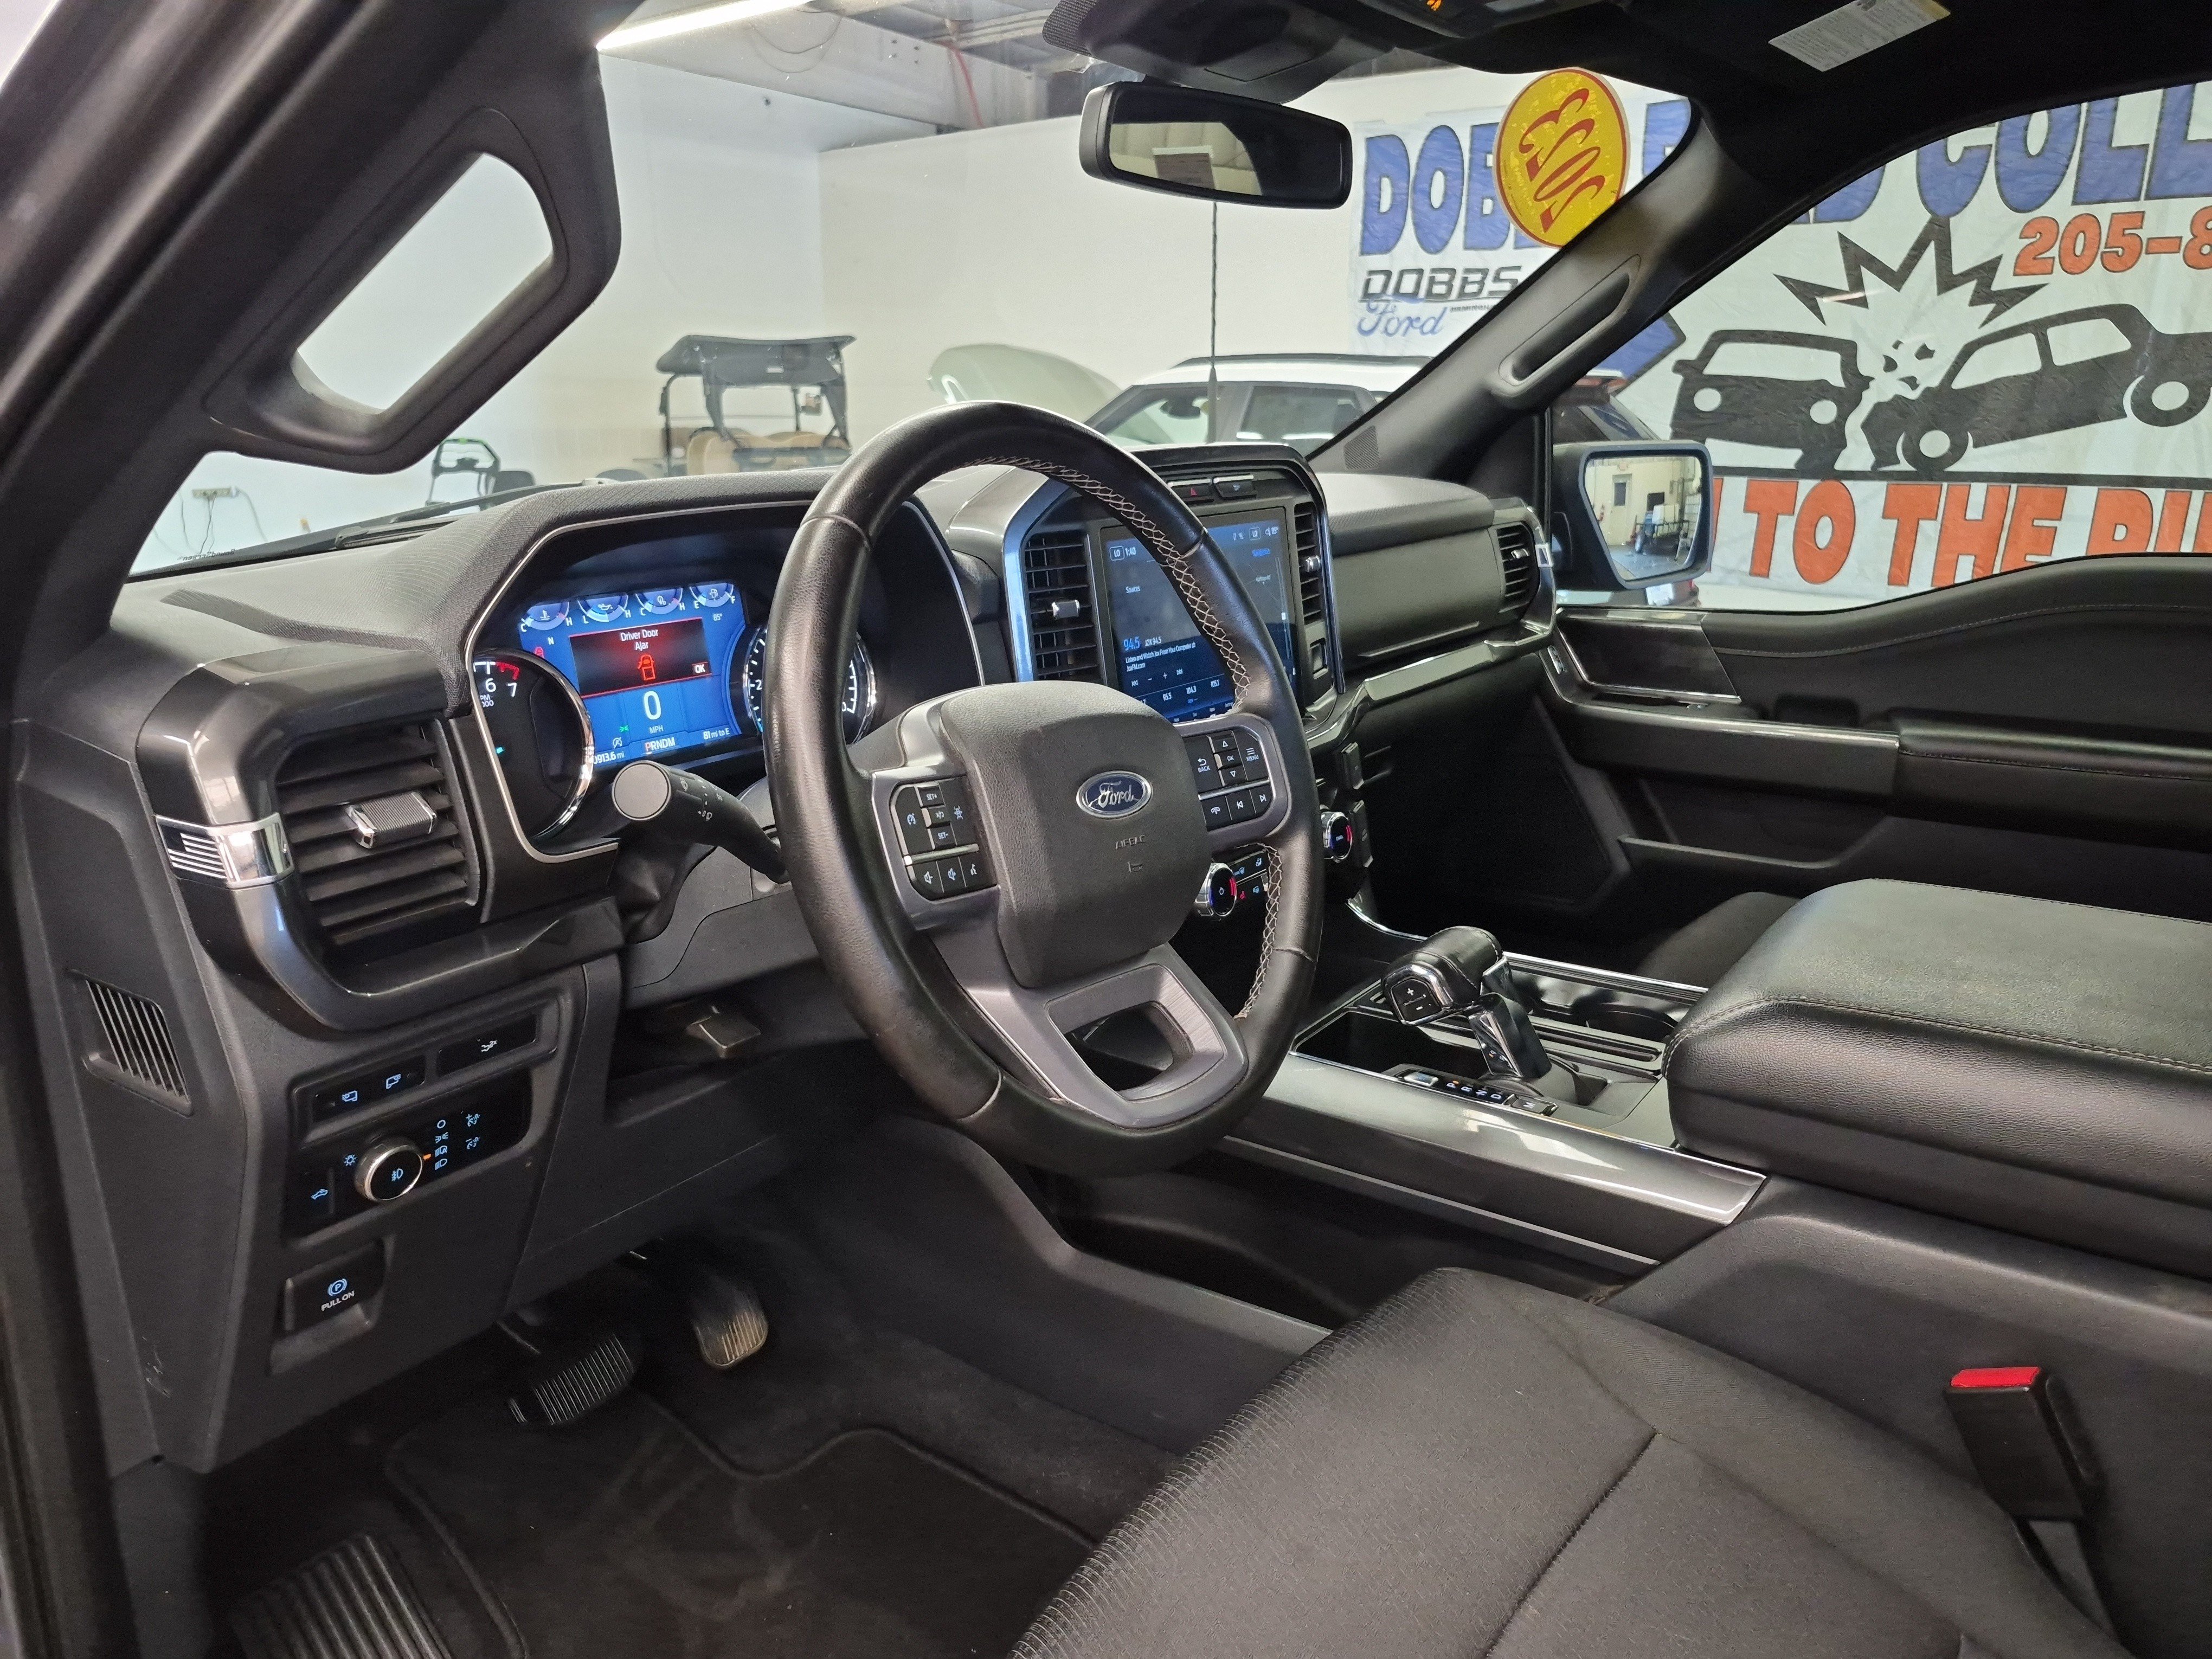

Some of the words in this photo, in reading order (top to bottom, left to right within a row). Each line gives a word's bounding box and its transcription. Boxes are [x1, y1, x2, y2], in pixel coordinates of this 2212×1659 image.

[1359, 122, 1545, 256] DOB
[2013, 207, 2212, 276] 205-8
[1360, 266, 1522, 299] DOBBS
[1357, 293, 1448, 337] Ford
[1744, 479, 1856, 584] TO
[1882, 482, 2067, 587] THE
[1125, 546, 1136, 556] 1:40
[1126, 585, 1141, 594] Sources
[694, 601, 700, 609] E
[731, 596, 736, 604] F
[679, 602, 685, 610] H
[625, 609, 632, 618] H
[640, 607, 646, 616] C
[565, 617, 573, 626] H
[583, 615, 589, 624] L
[713, 613, 723, 621] 85°
[520, 623, 527, 632] C
[621, 631, 641, 641] Driver
[642, 629, 659, 638] Door
[548, 636, 555, 645] N
[1123, 636, 1140, 651] 94.5
[635, 641, 649, 652] Ajar
[695, 664, 705, 674] OK
[485, 678, 497, 692] 6
[755, 679, 763, 690] 2
[1210, 679, 1219, 688] 105.1
[507, 682, 517, 697] 7
[1162, 692, 1172, 702] 95.5
[643, 690, 661, 720] 0
[650, 724, 664, 734] MPH
[703, 731, 711, 740] 81
[725, 727, 730, 735] E
[645, 737, 676, 753] PRNDM
[616, 751, 625, 759] mi
[1095, 780, 1137, 808] Ford
[320, 1297, 342, 1311] PULL
[342, 1290, 355, 1301] ON
